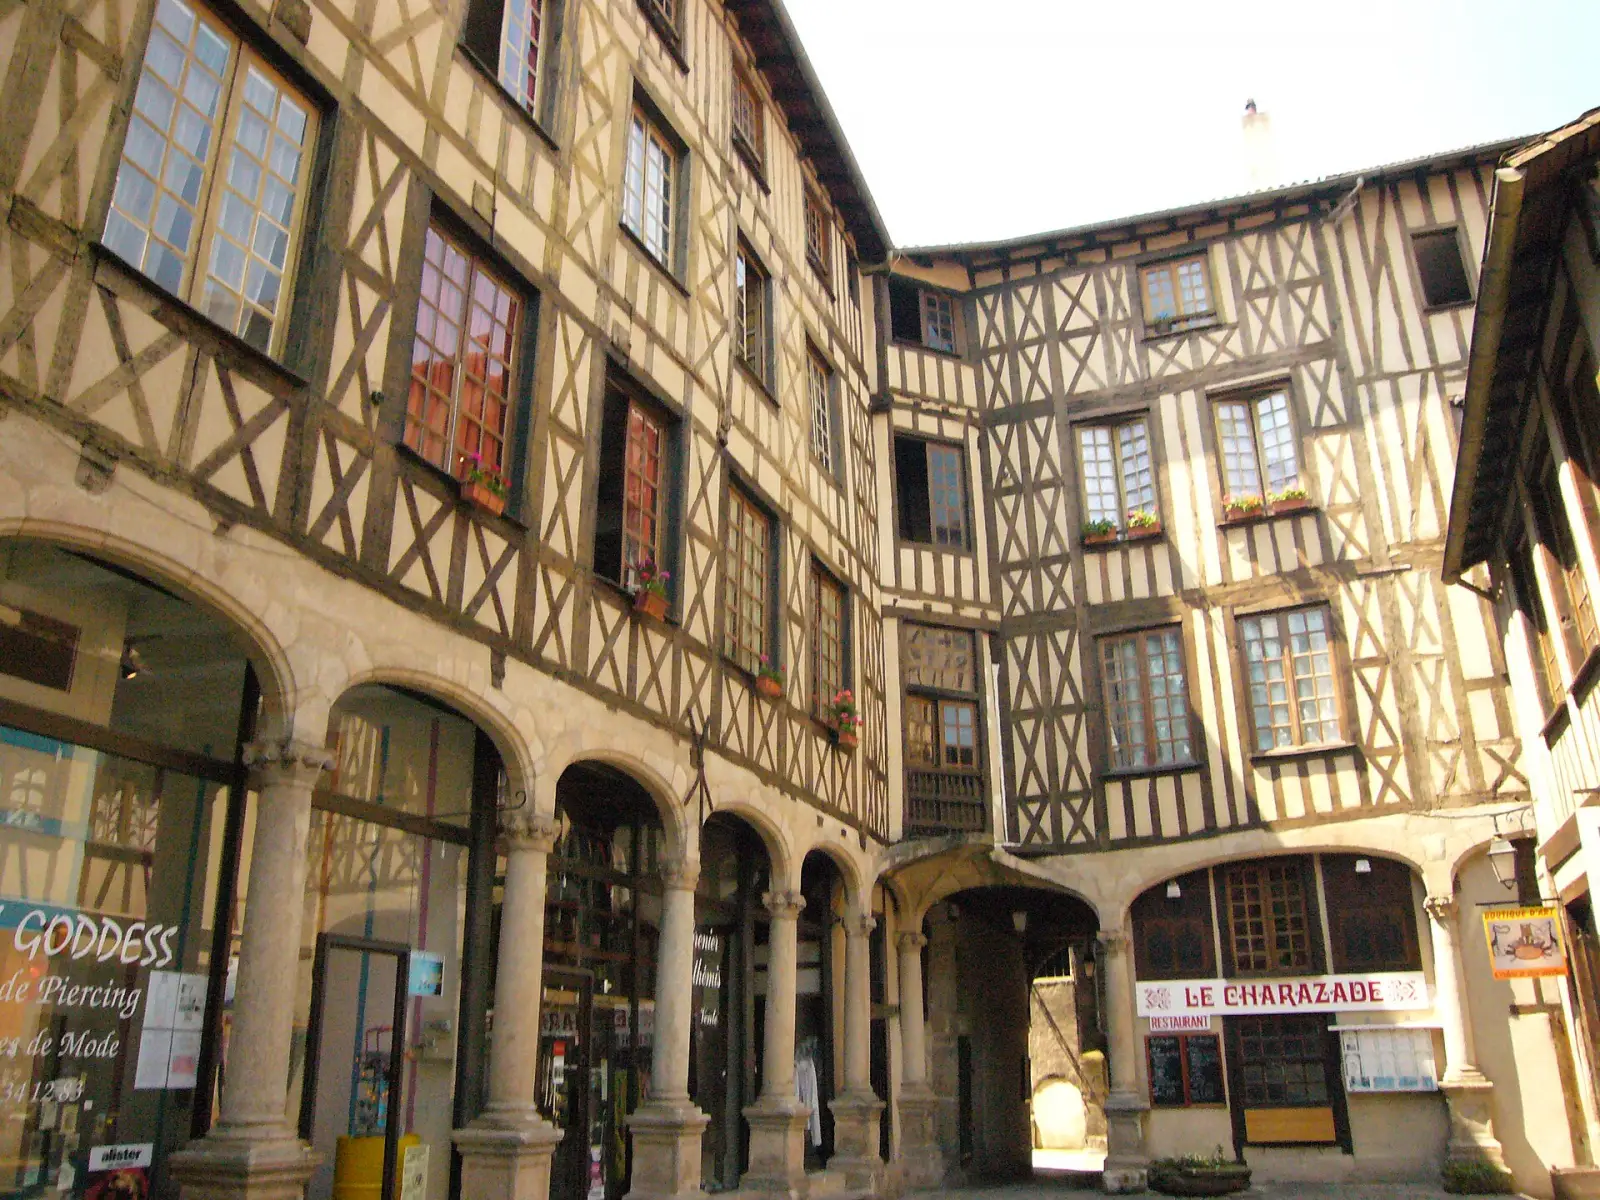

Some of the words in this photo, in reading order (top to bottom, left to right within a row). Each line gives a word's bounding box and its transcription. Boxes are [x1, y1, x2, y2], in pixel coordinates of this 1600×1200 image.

[1484, 908, 1527, 920] BOUTIQUE
[14, 909, 178, 968] GODDESS
[0, 968, 29, 1001] de
[36, 976, 142, 1020] Piercing
[1184, 986, 1215, 1008] LE
[1223, 981, 1384, 1008] CHARAZADE
[1151, 1015, 1209, 1030] RESTAURANT
[26, 1027, 53, 1058] de
[57, 1029, 121, 1059] Mode
